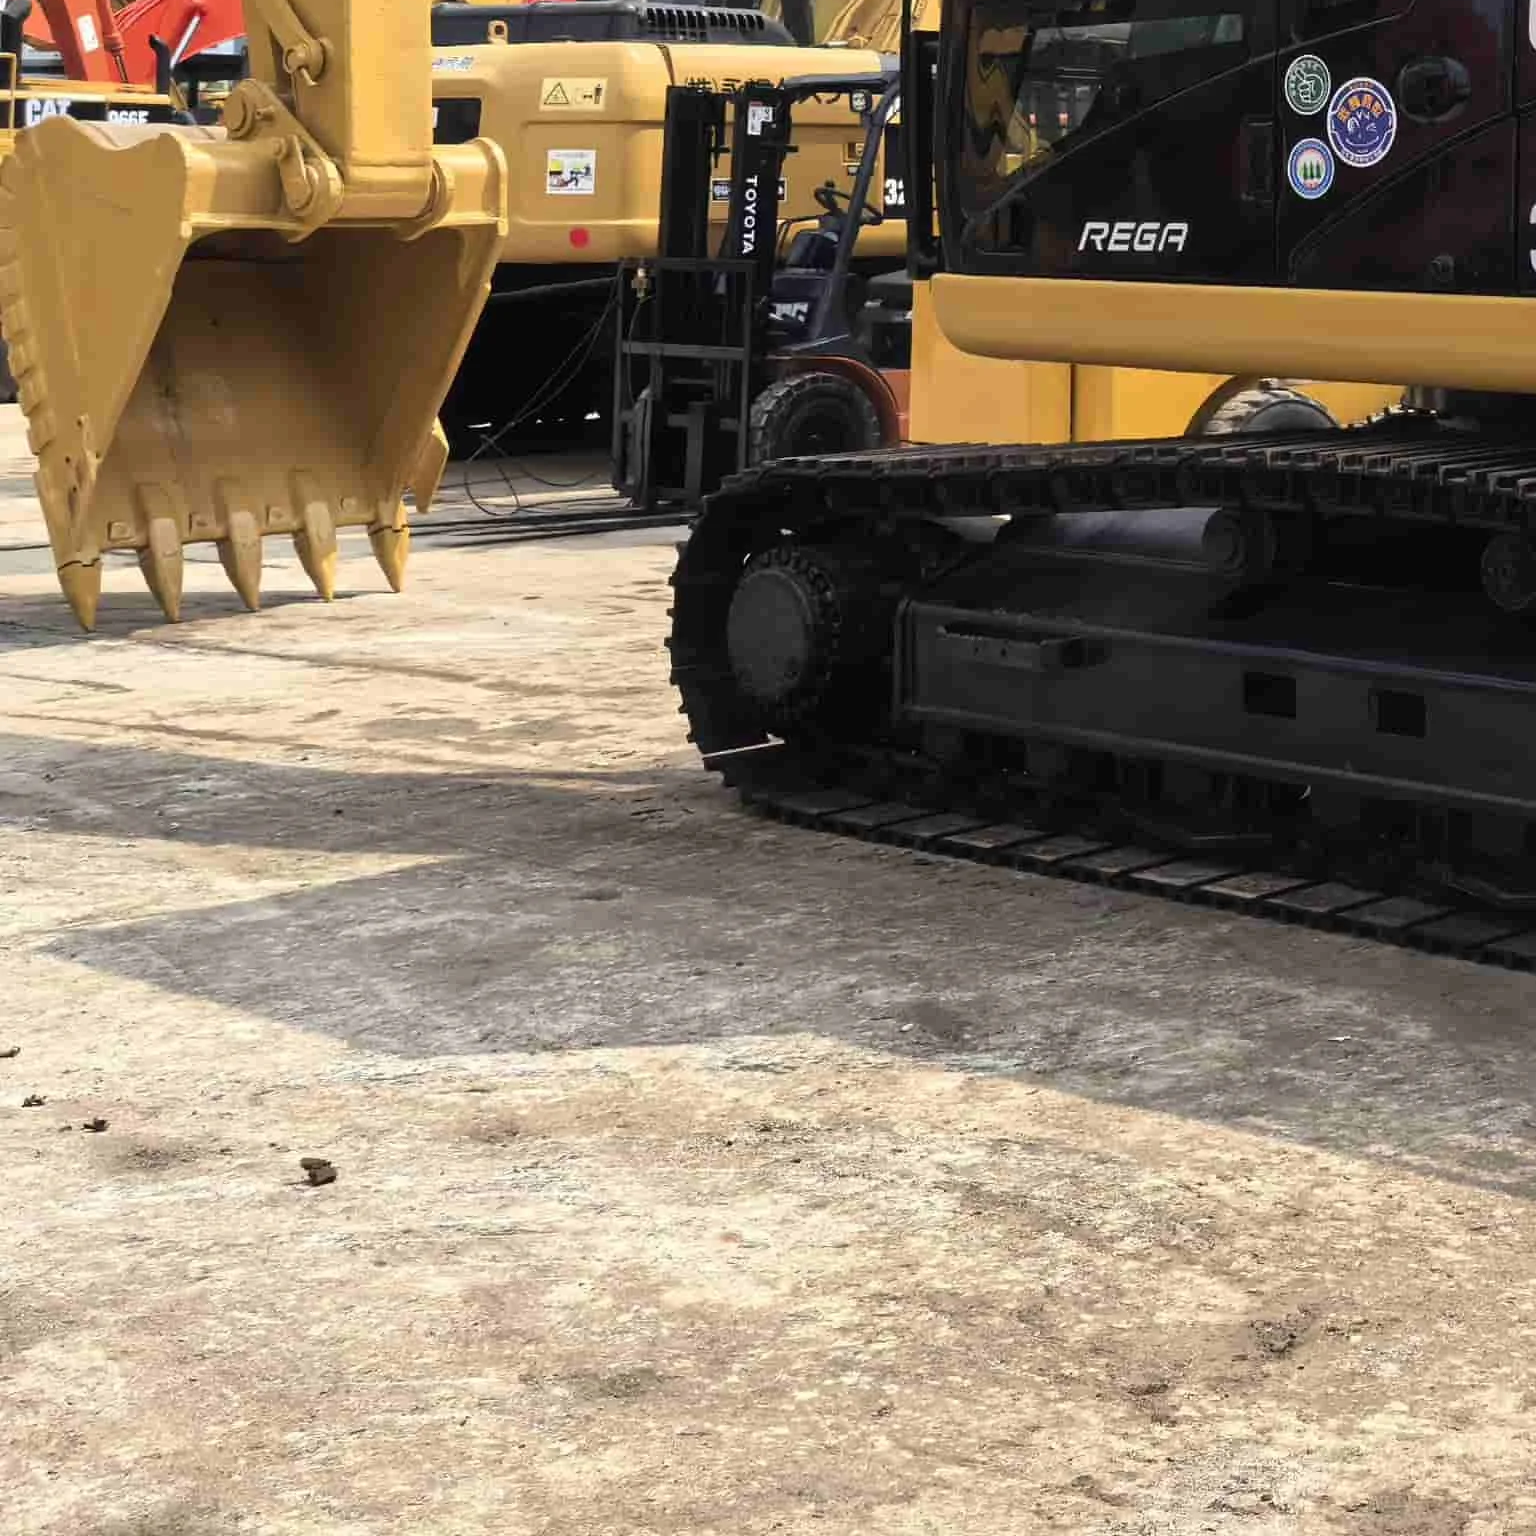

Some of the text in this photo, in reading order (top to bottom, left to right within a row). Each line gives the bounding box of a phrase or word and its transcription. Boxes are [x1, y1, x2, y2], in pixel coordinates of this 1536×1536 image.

[25, 99, 71, 129] CAT
[741, 175, 758, 255] TOYOTA
[1077, 222, 1188, 252] REGA
